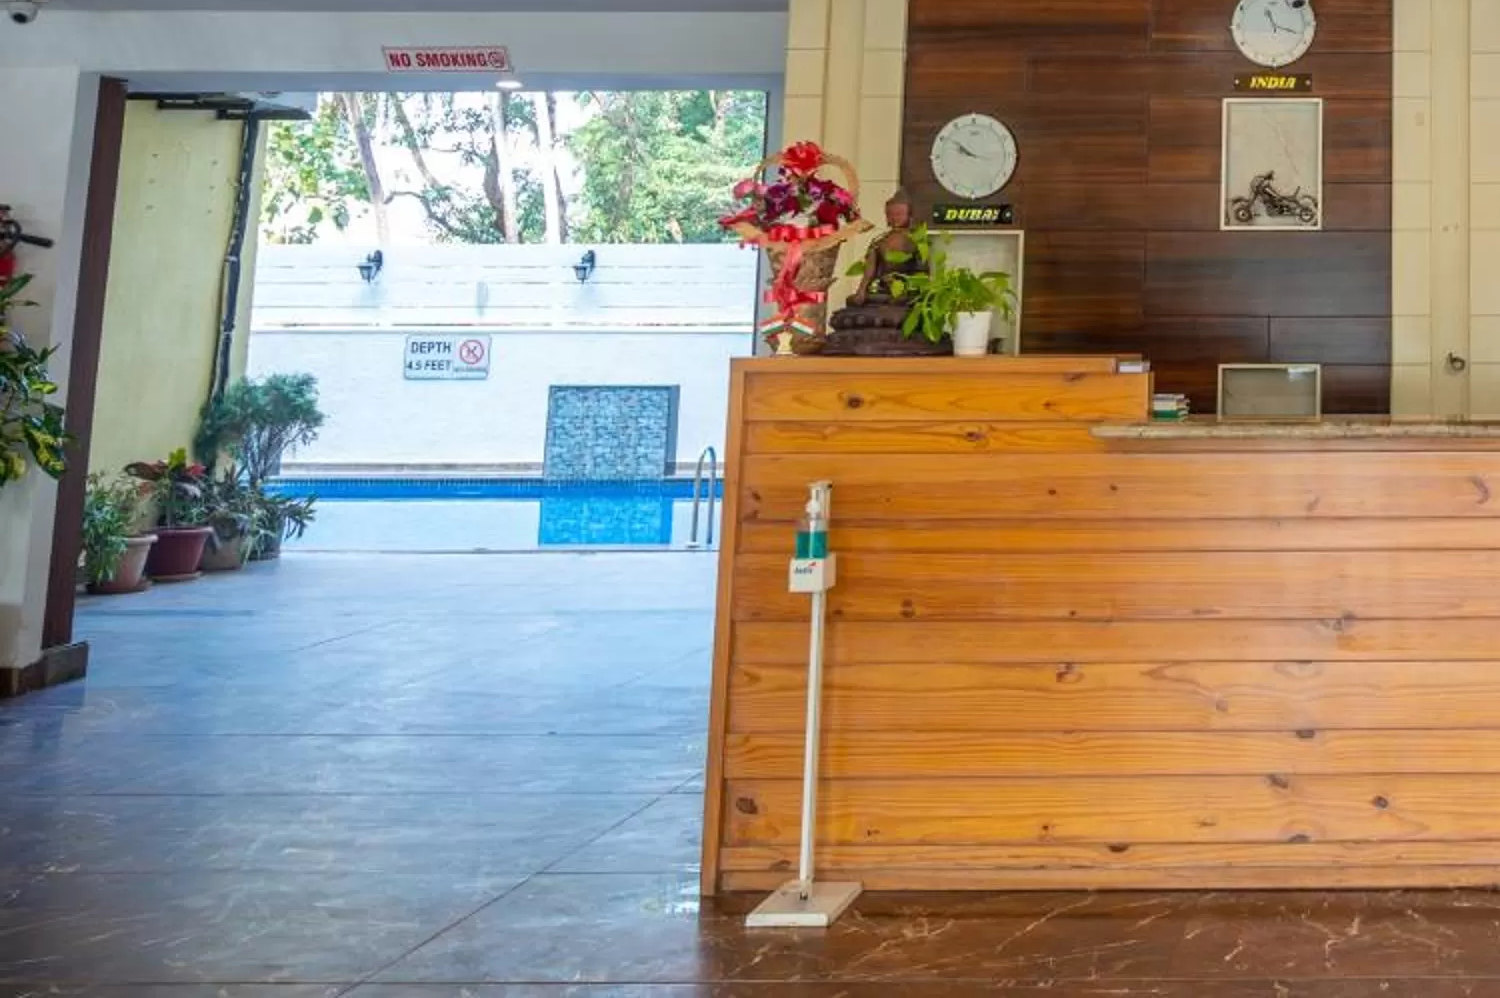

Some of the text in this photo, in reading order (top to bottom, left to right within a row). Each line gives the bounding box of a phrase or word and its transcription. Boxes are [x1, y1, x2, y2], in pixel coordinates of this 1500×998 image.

[389, 53, 487, 68] NO SMOKING
[1249, 76, 1297, 89] INDIA
[944, 208, 1001, 221] DUBAI
[410, 341, 452, 354] DEPTH
[424, 359, 453, 371] FEET
